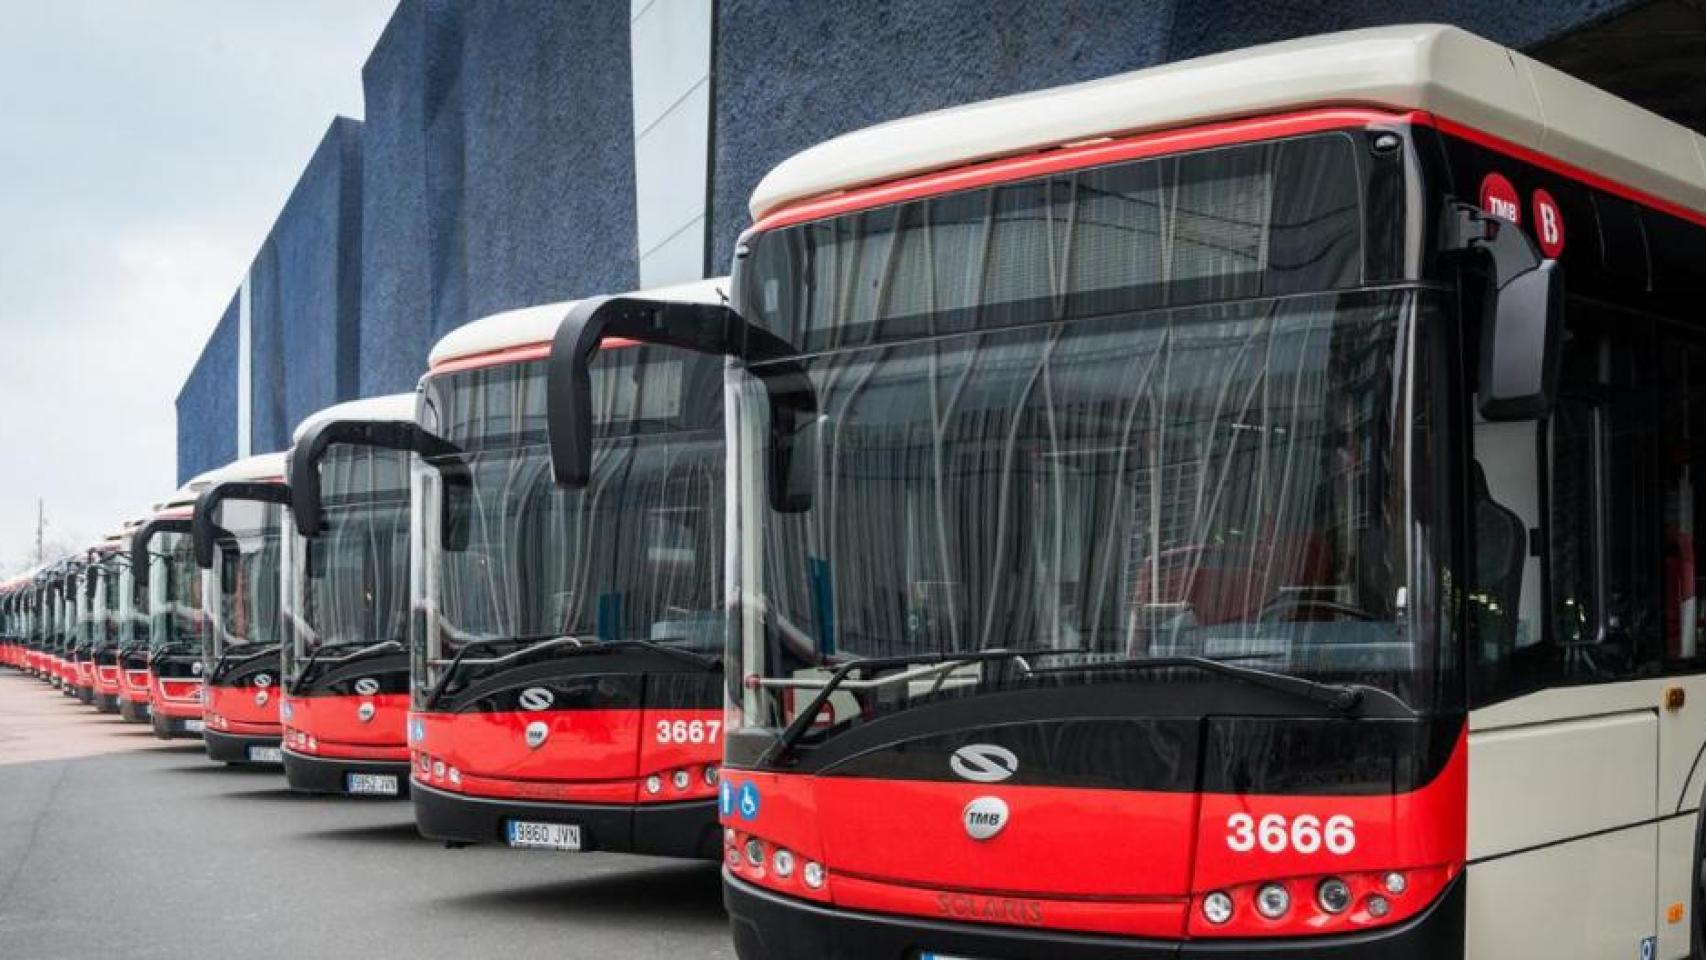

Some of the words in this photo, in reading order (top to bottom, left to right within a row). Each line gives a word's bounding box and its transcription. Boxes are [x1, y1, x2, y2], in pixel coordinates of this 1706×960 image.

[1489, 195, 1516, 223] TMB
[1539, 203, 1559, 244] B
[656, 720, 721, 744] 3667
[968, 811, 1001, 826] TMB
[518, 823, 550, 843] 9860
[554, 825, 578, 845] JVN
[1227, 812, 1356, 855] 3666
[937, 893, 1043, 923] SOLARIS
